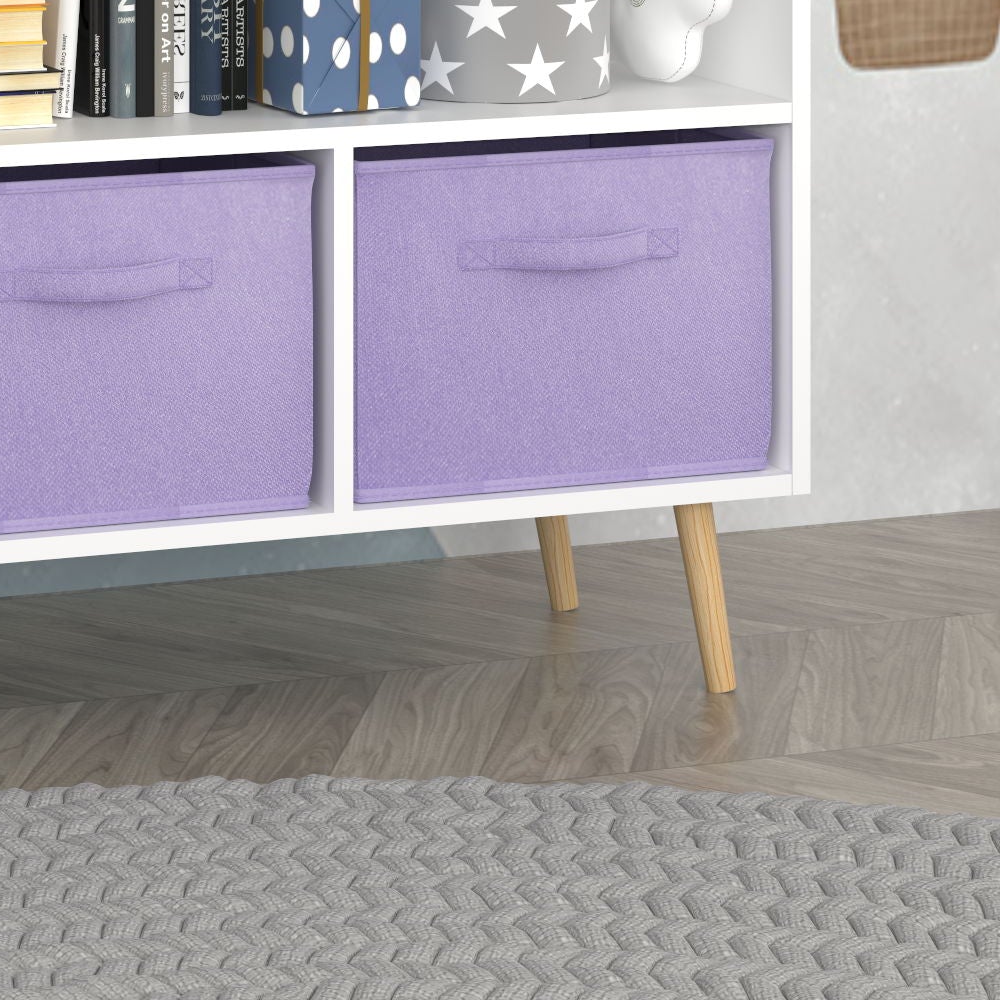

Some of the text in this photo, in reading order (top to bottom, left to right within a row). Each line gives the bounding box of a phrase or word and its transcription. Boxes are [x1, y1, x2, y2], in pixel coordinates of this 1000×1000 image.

[161, 15, 170, 34] on
[61, 33, 69, 51] James
[161, 37, 172, 63] Art
[59, 51, 67, 66] Craig
[92, 34, 101, 114] James Craig William Bevington
